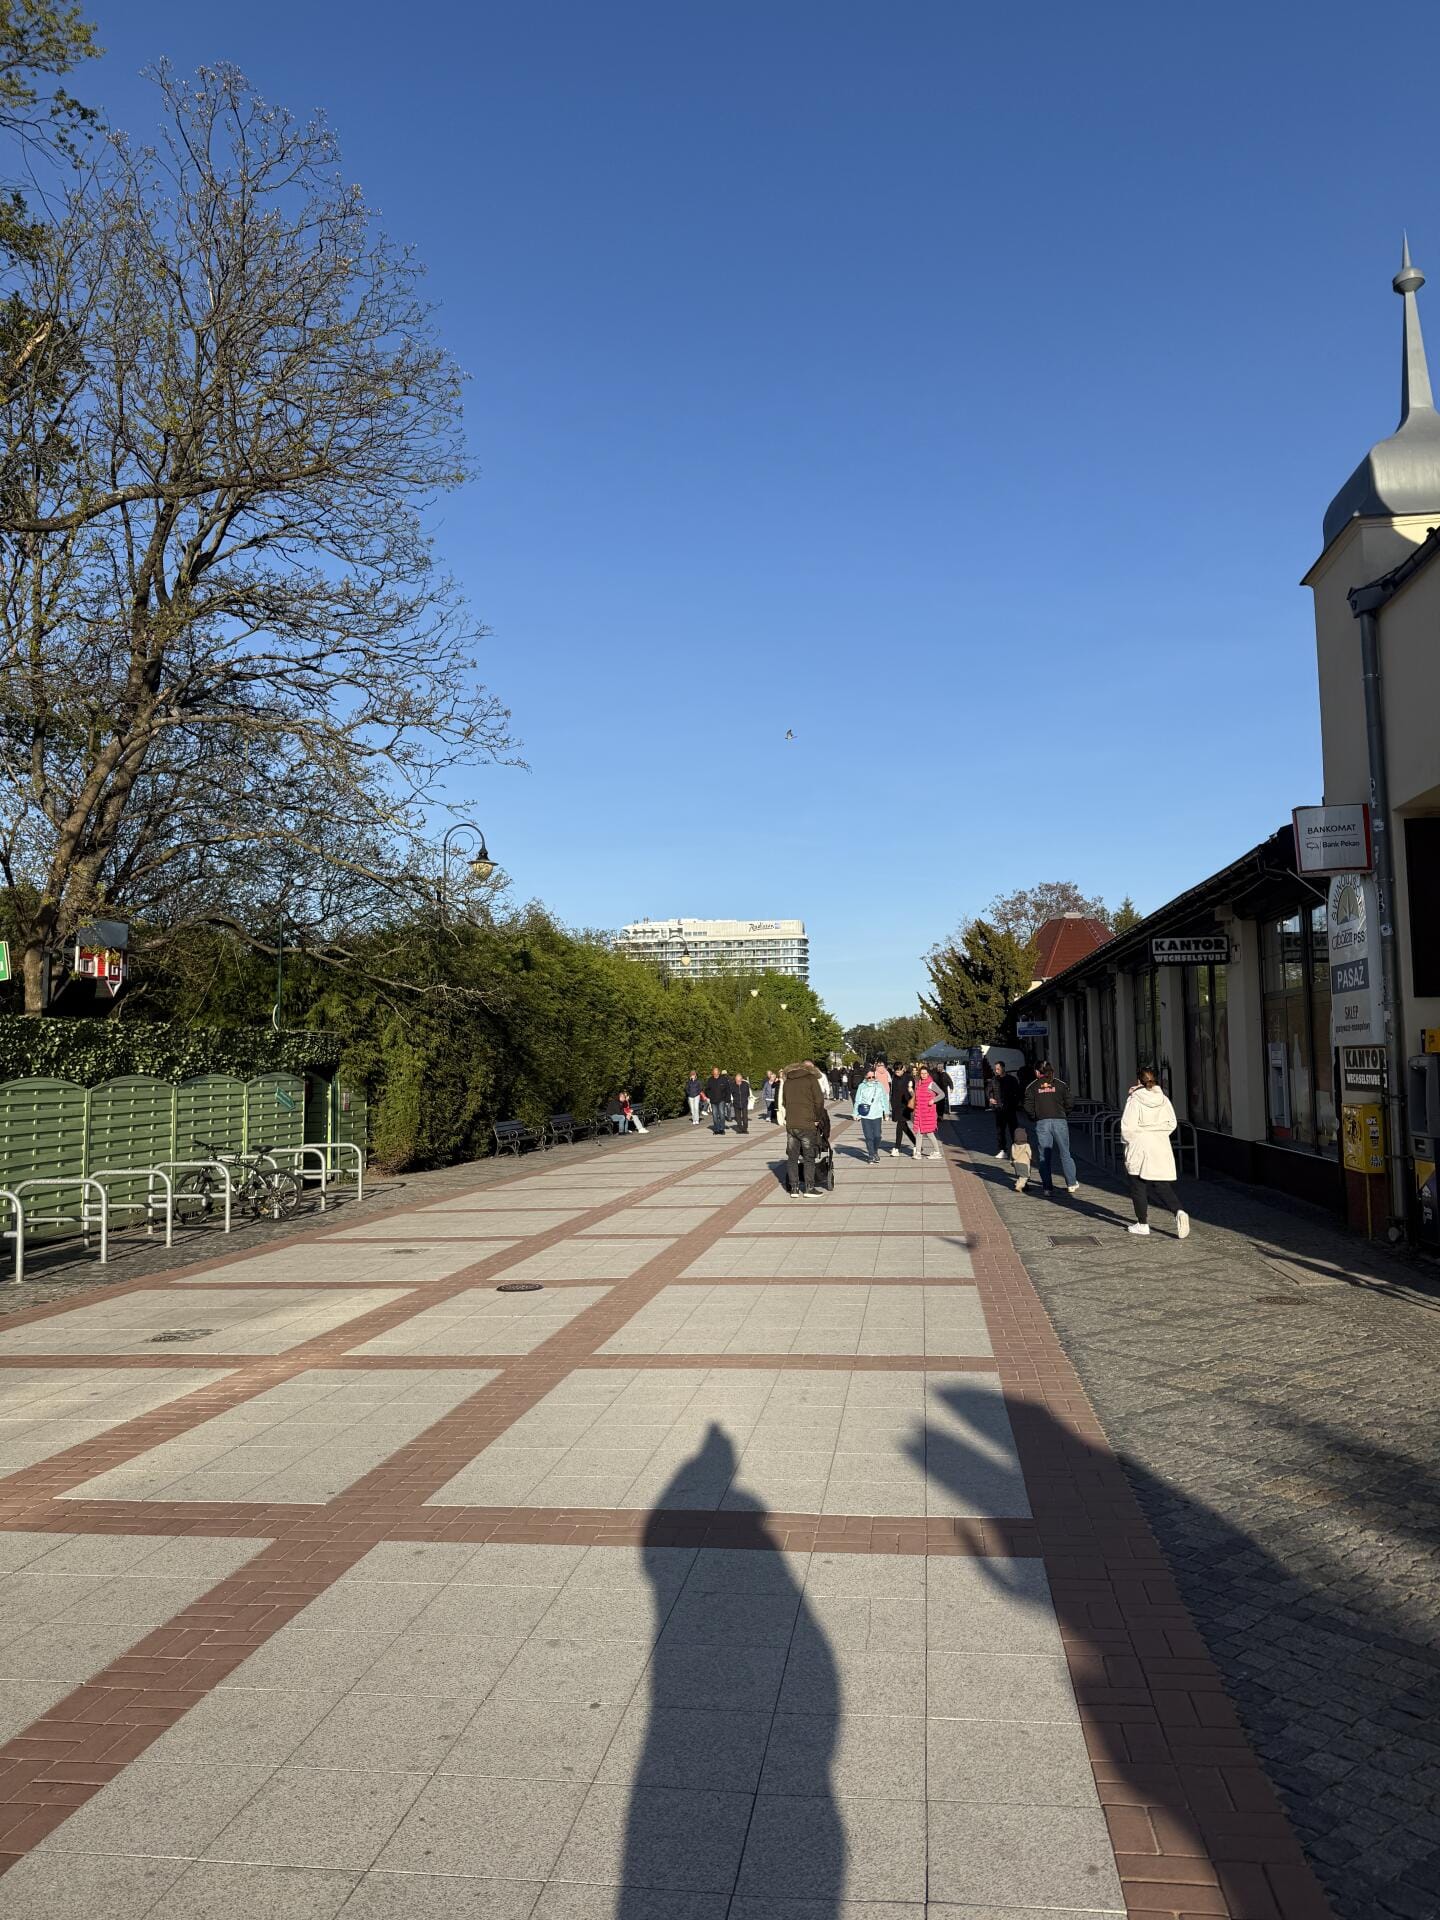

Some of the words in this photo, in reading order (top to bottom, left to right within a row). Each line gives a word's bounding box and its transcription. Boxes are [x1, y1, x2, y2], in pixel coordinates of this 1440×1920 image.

[1307, 823, 1356, 834] BANKOMAT
[1154, 938, 1226, 951] KANTOR
[1353, 930, 1366, 945] PSS
[1153, 953, 1227, 962] WECHSELSTUBE
[1337, 961, 1365, 990] PASAŻ
[1344, 1005, 1359, 1020] SKLEP
[1345, 1048, 1386, 1069] KANTOR
